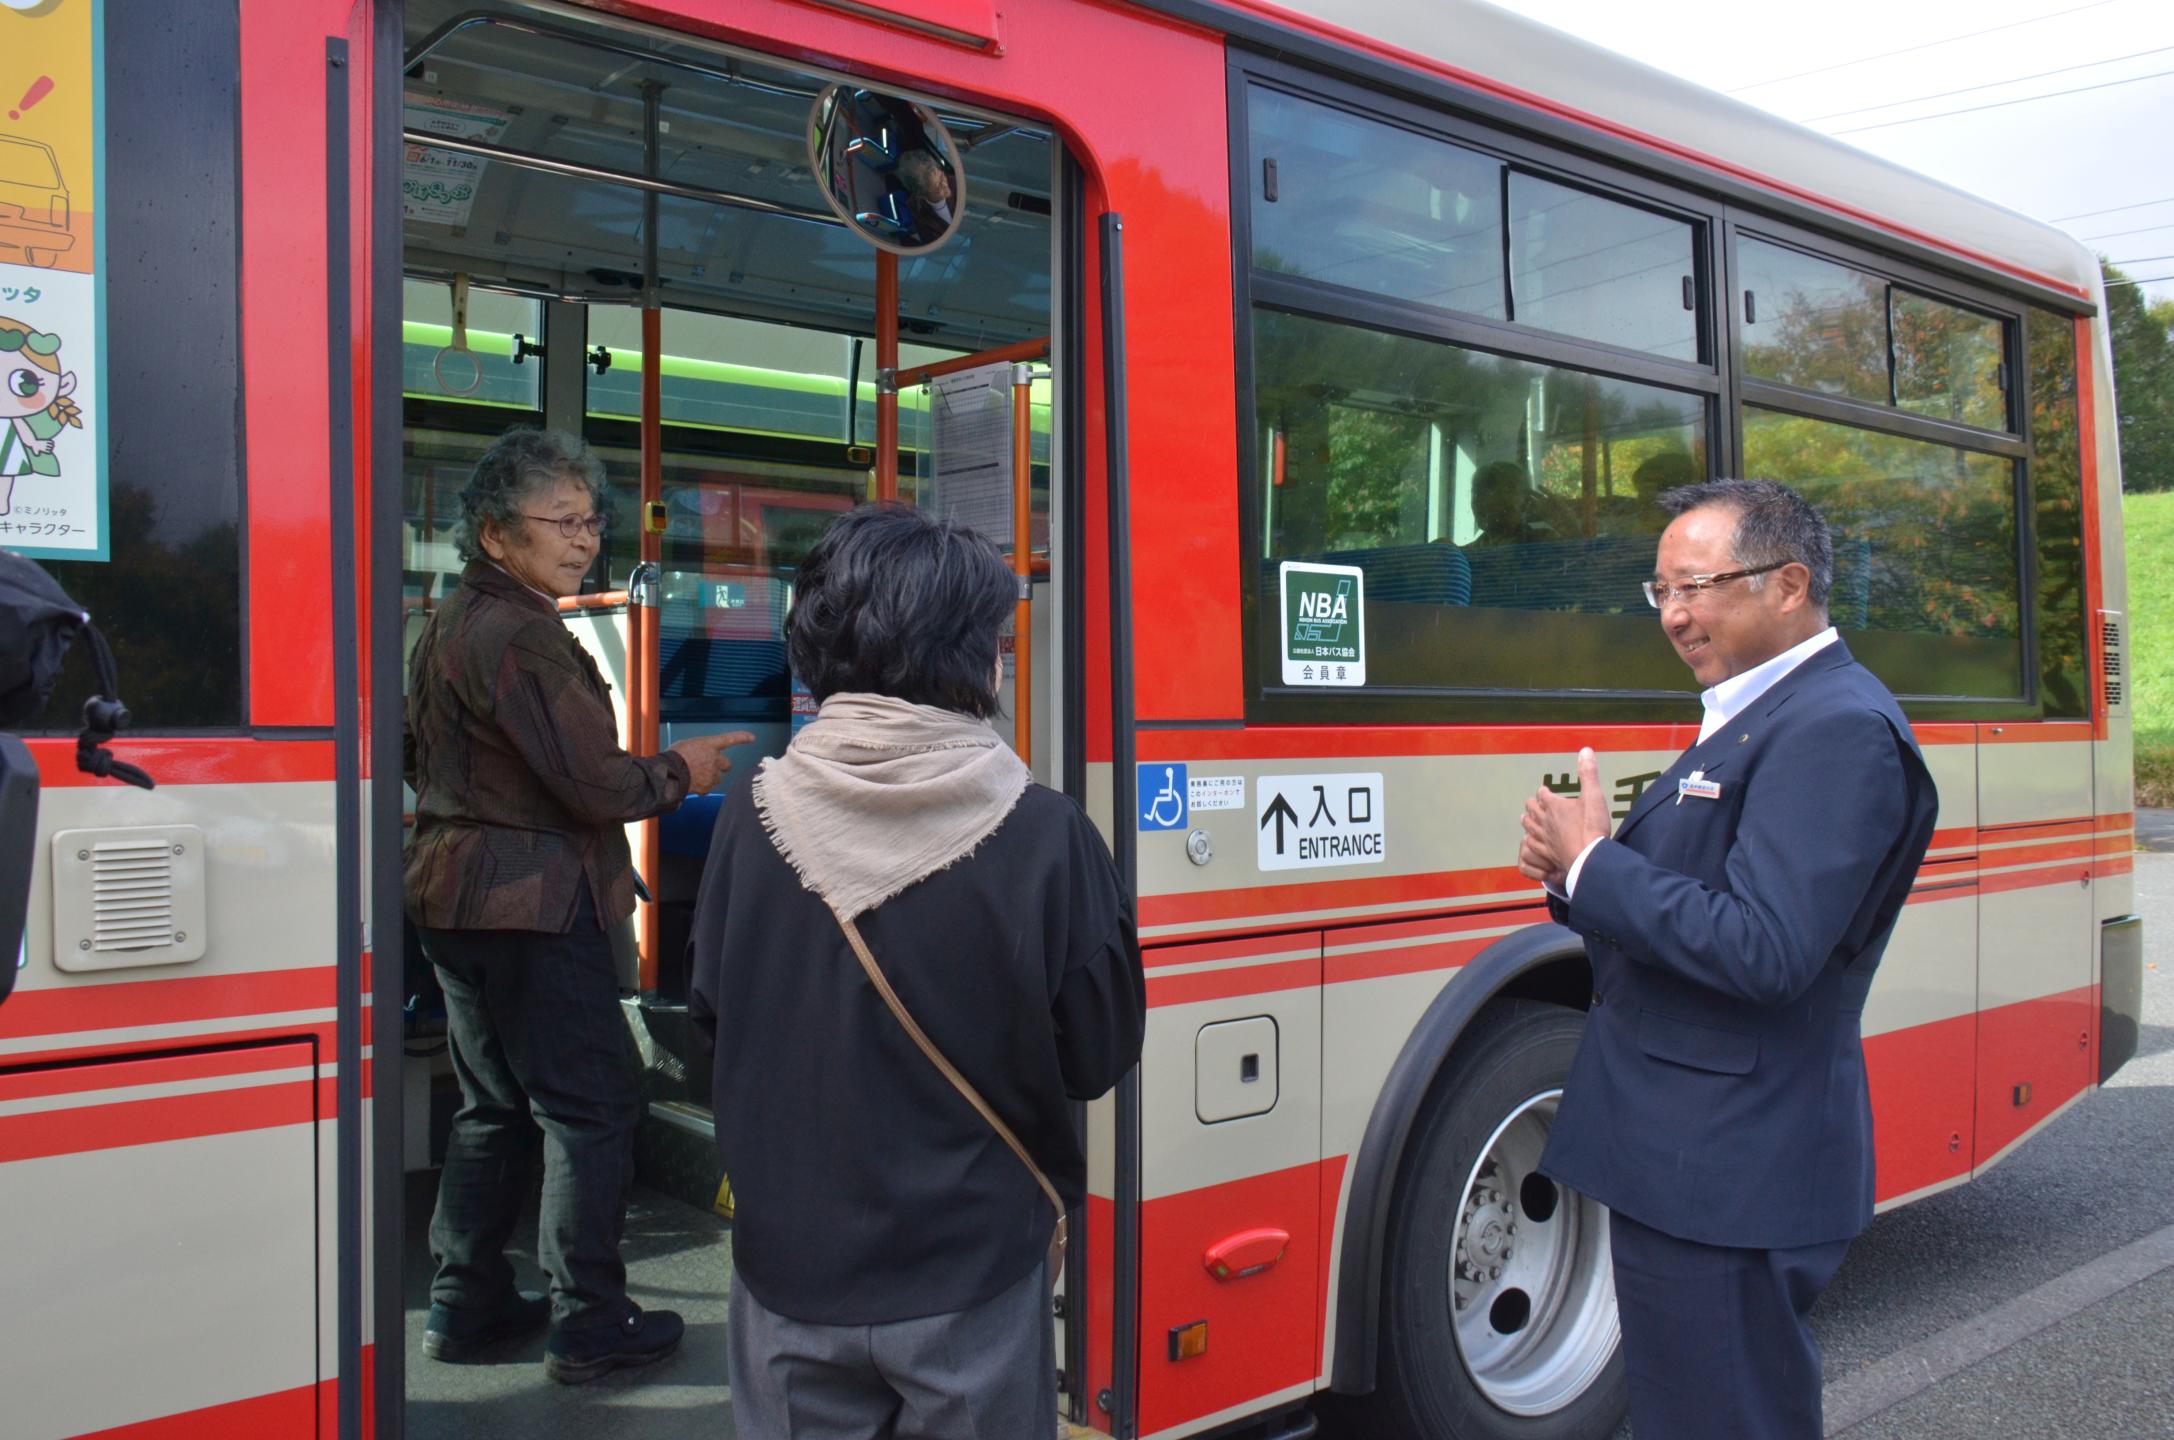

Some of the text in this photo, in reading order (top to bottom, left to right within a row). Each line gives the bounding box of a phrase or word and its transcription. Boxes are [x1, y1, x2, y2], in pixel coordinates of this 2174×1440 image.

[0, 521, 86, 536] キャラクター
[1299, 592, 1348, 619] NBA
[1315, 646, 1356, 658] 日本バス協会
[1303, 665, 1347, 680] 会員章
[1309, 785, 1371, 828] 入口
[1299, 833, 1382, 860] ENTRANCE
